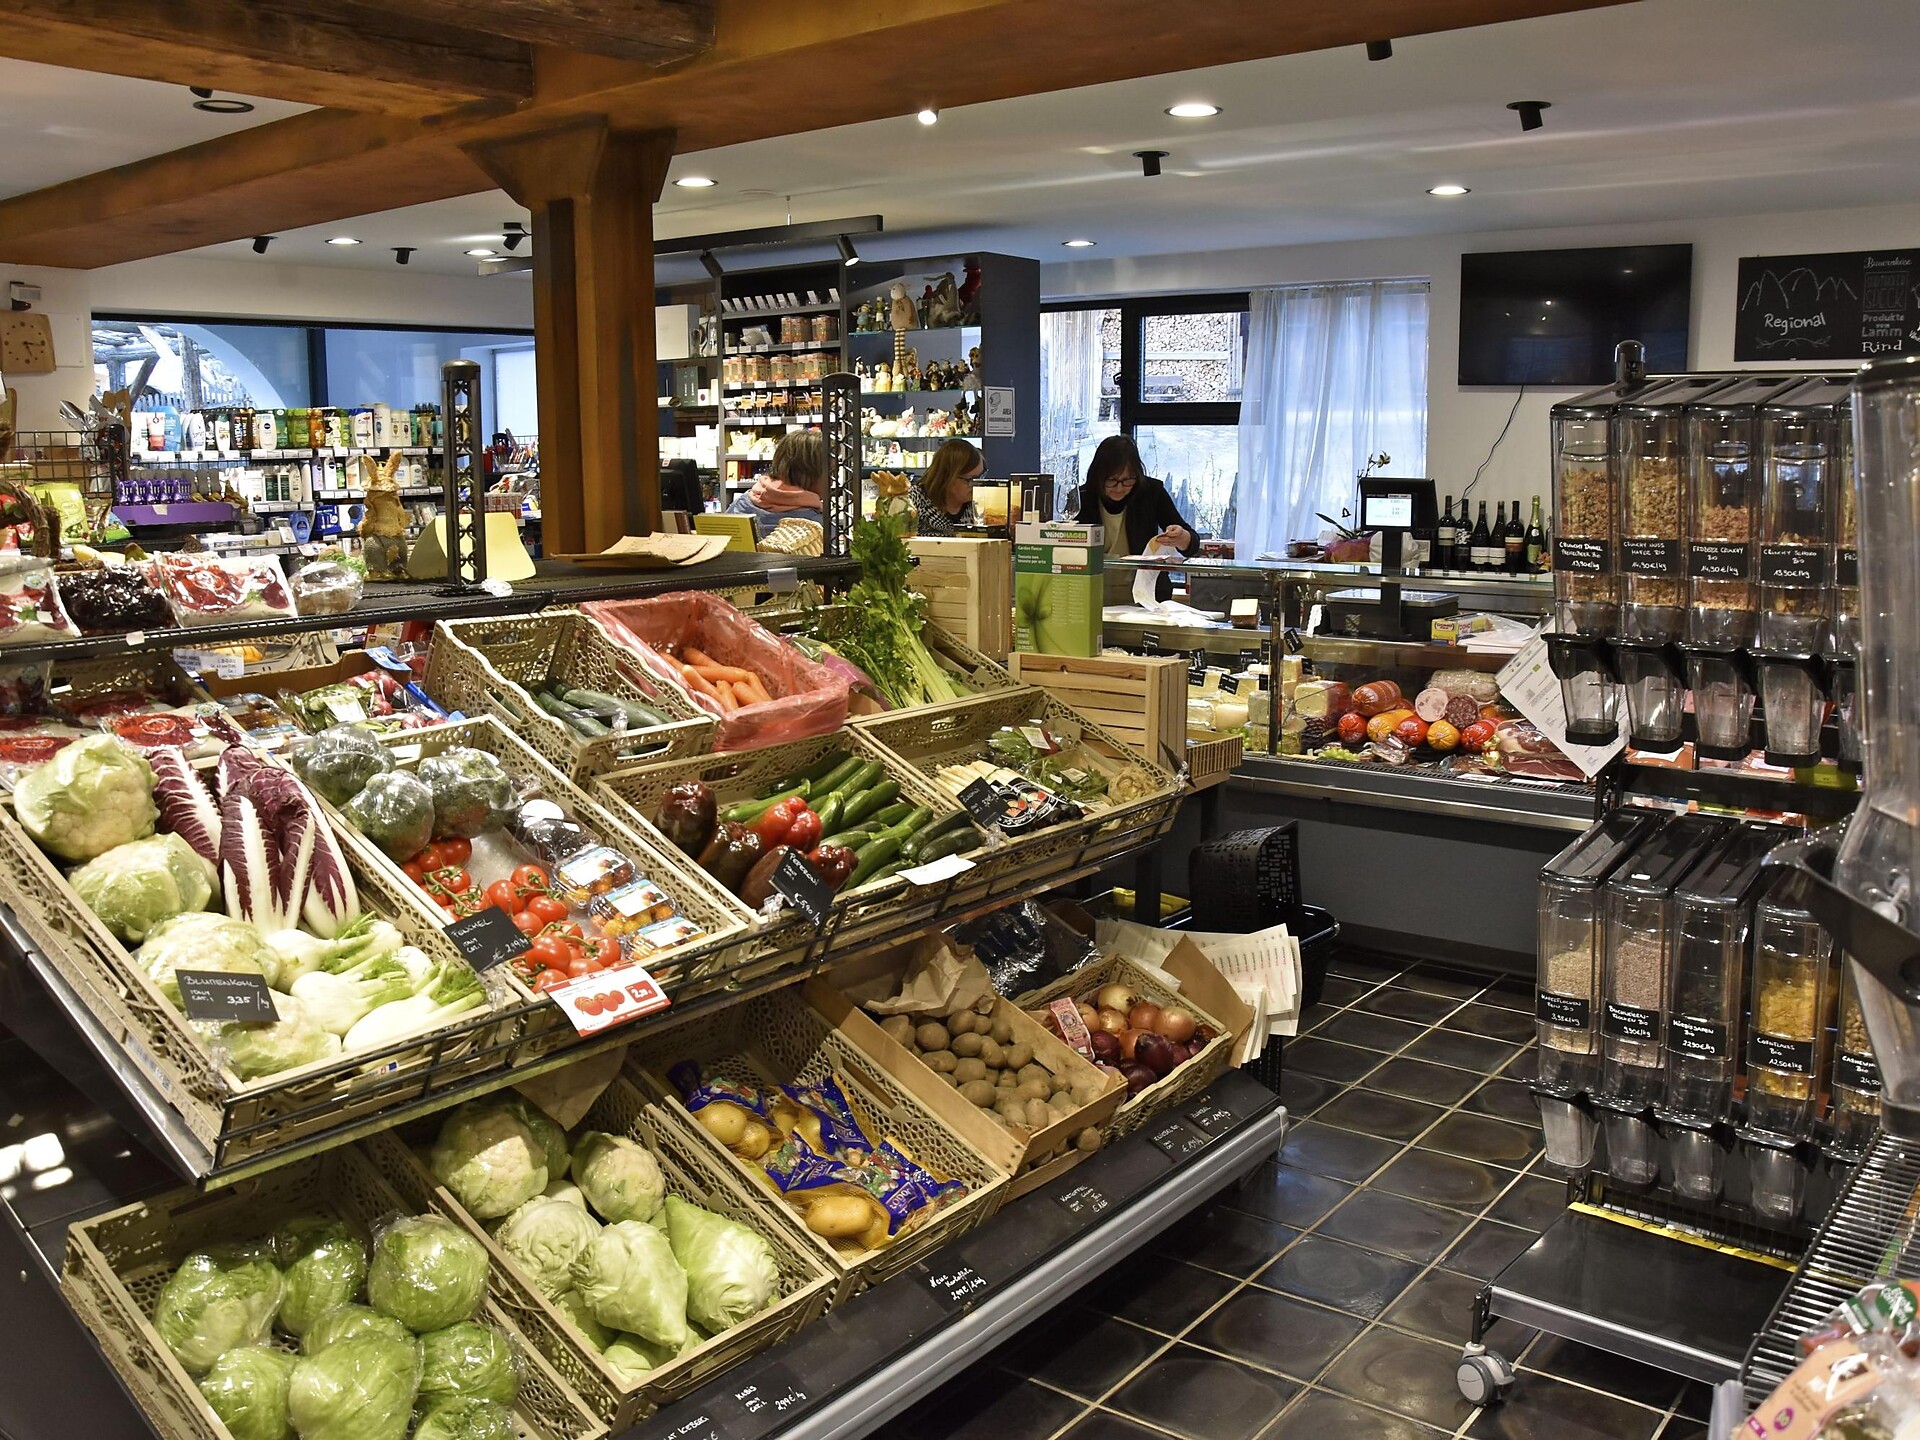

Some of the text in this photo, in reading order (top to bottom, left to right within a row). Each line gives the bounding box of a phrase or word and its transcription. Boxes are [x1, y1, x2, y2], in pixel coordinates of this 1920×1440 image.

[1764, 312, 1826, 336] Regional
[1862, 313, 1904, 323] Produkte
[1861, 327, 1902, 338] Lamm
[1861, 339, 1902, 354] Rind
[1045, 531, 1087, 539] WINDHAGER
[928, 1274, 949, 1288] Neue
